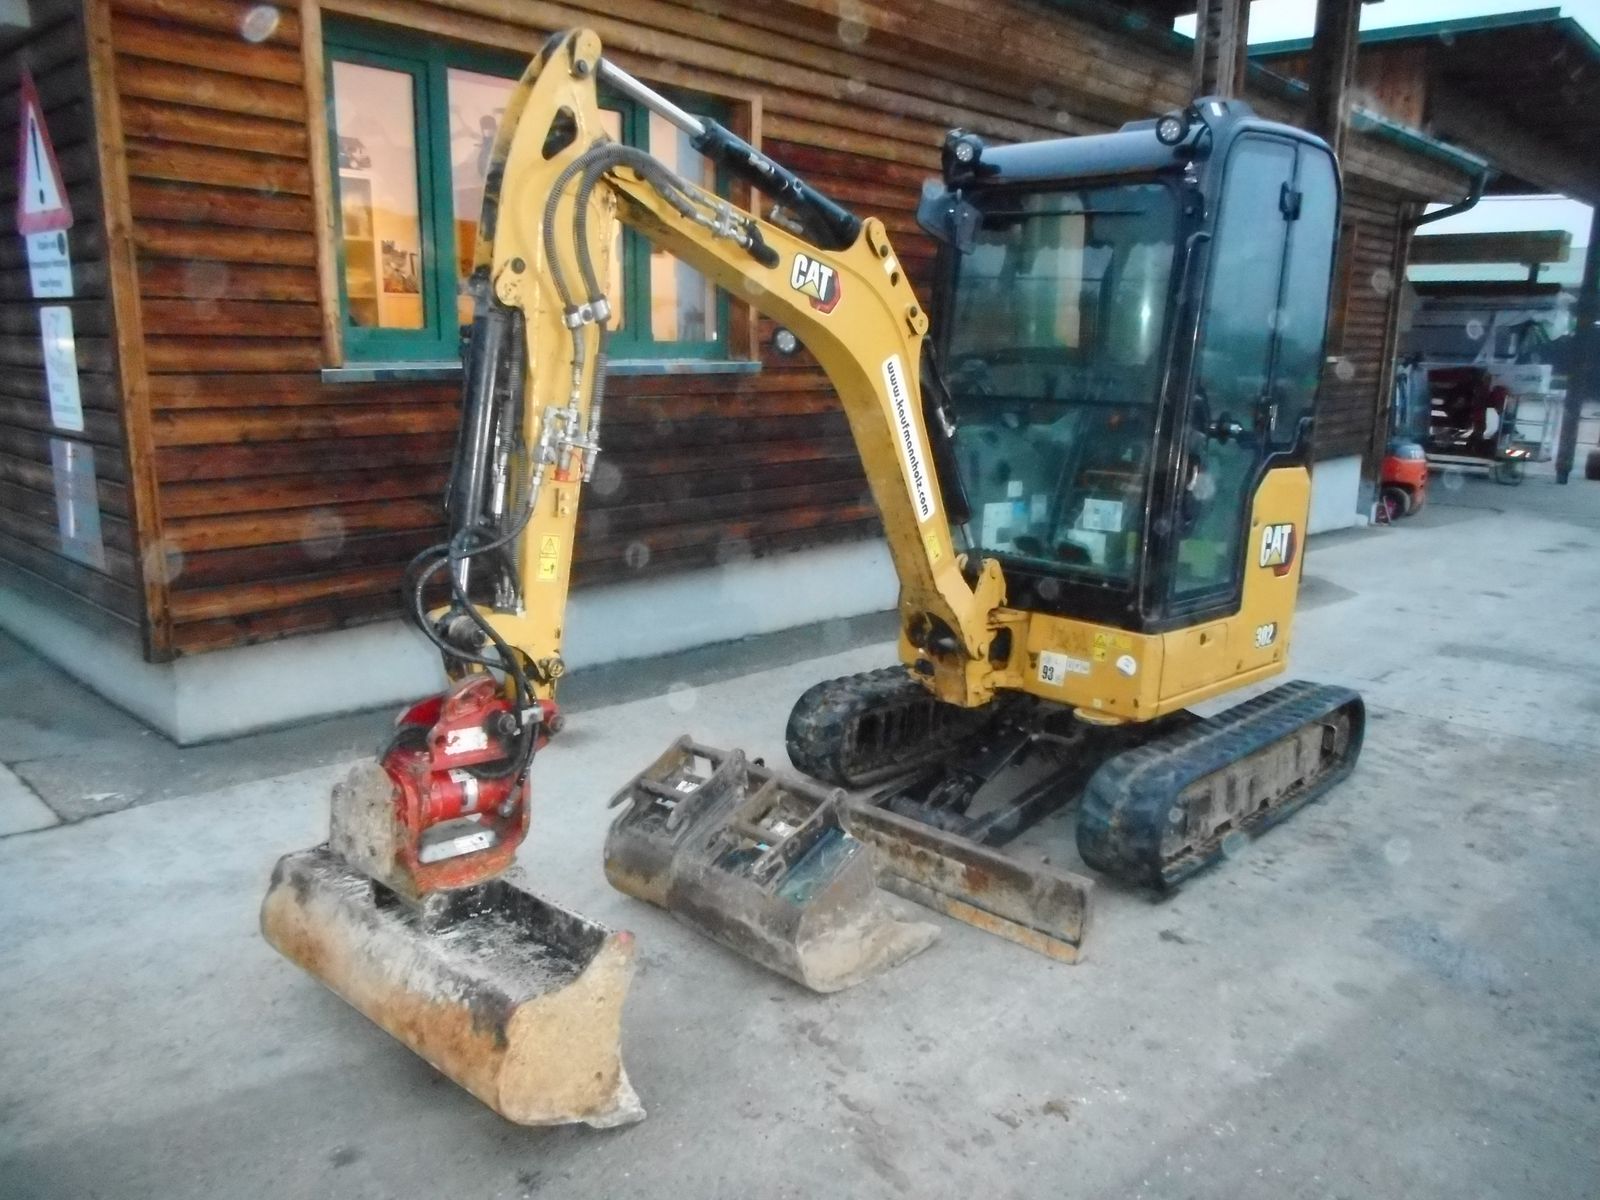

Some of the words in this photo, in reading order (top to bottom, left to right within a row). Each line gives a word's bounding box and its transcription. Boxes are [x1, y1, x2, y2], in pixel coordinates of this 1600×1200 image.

[790, 253, 833, 302] CAT
[886, 361, 930, 517] www.kaufmannholz.com
[1260, 524, 1293, 567] CAT
[1256, 623, 1275, 648] 302
[1041, 664, 1055, 681] 93
